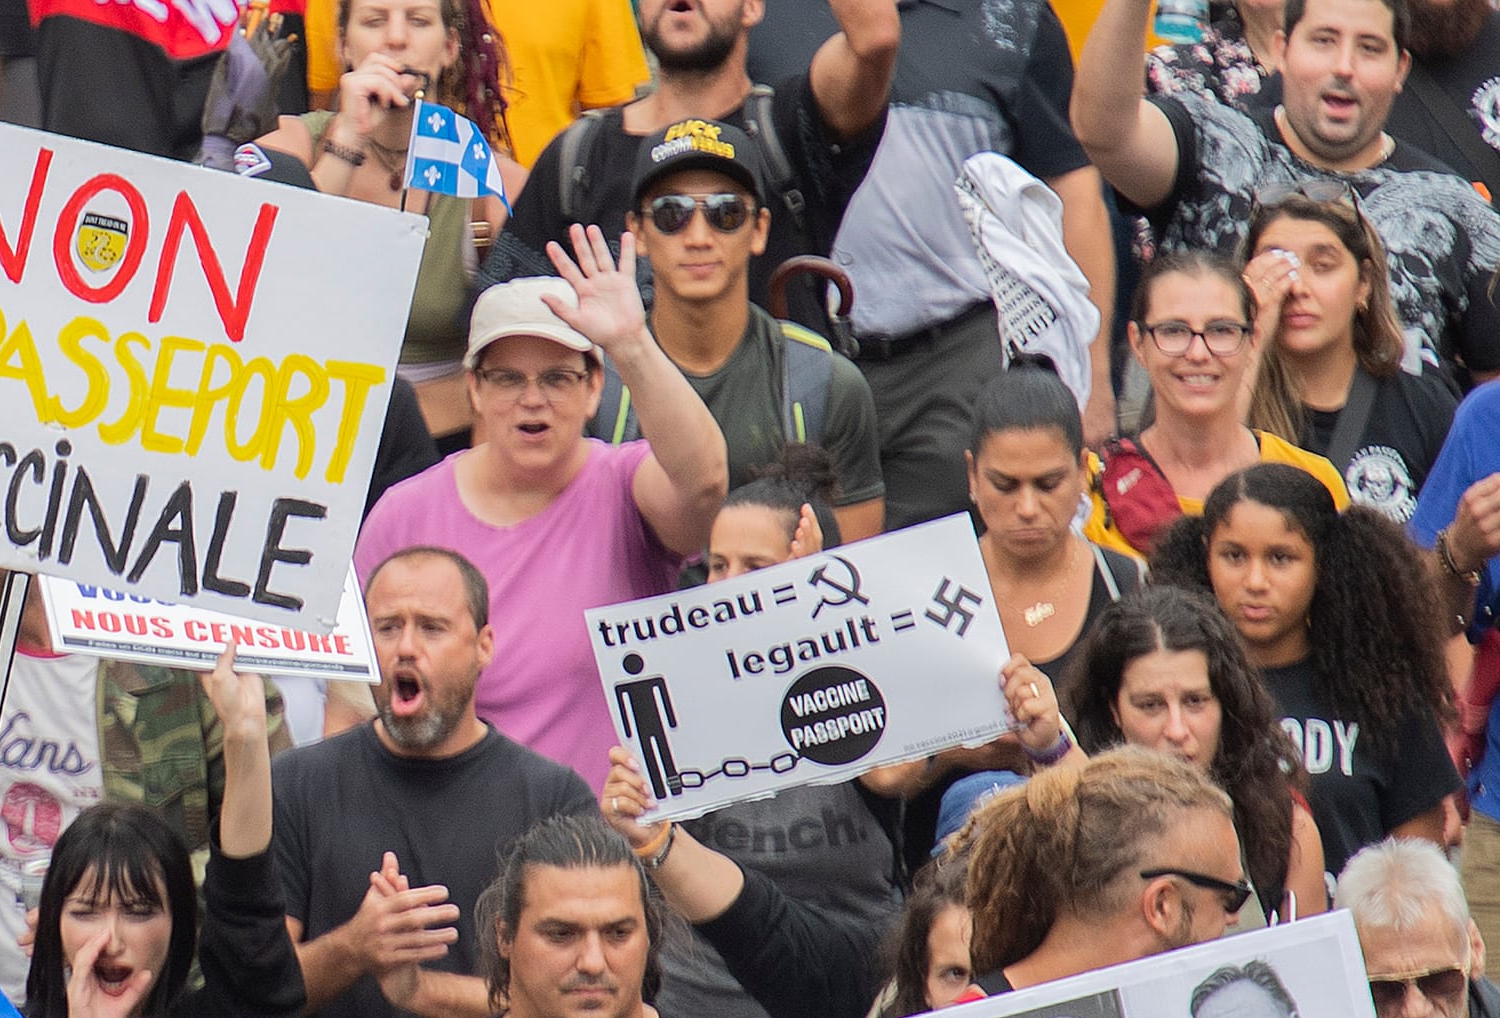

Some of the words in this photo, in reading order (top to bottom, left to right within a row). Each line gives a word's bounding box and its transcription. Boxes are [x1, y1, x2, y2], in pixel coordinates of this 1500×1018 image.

[71, 607, 174, 639] NOUS
[184, 618, 354, 656] CENSURE
[599, 589, 763, 648] trudeau
[726, 613, 880, 680] legault
[790, 678, 871, 718] VACCINE
[790, 706, 886, 751] PASSPORT
[1277, 717, 1360, 776] ODY
[703, 805, 868, 852] ench.
